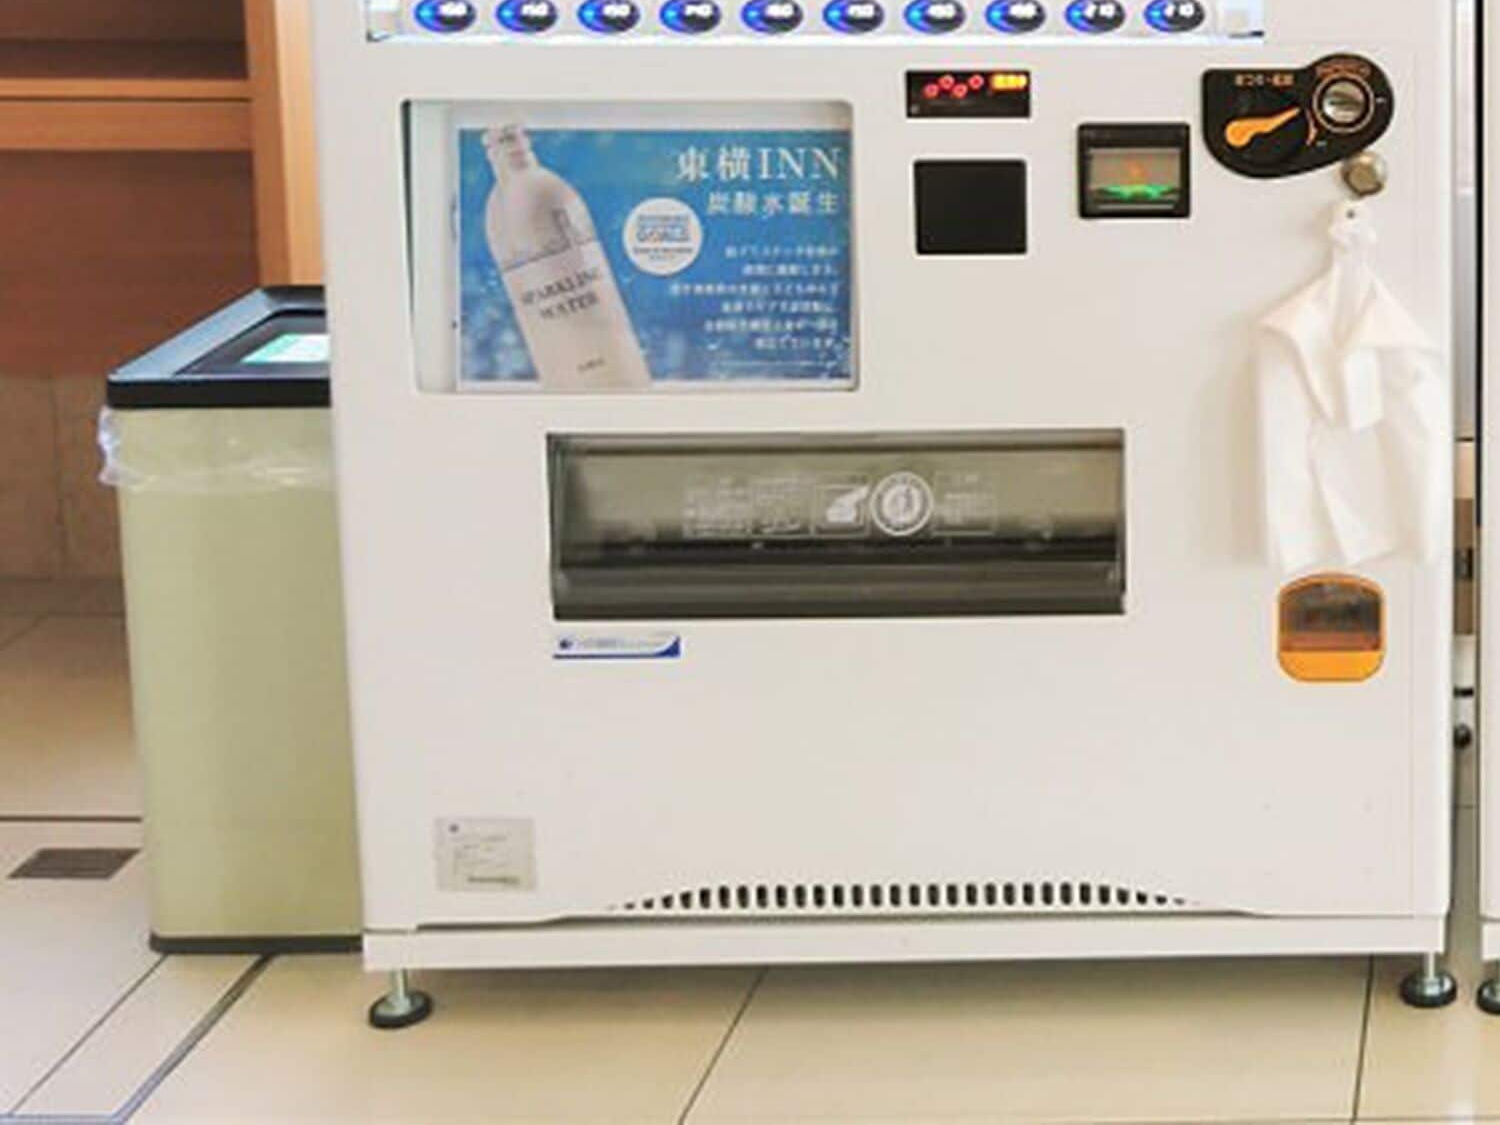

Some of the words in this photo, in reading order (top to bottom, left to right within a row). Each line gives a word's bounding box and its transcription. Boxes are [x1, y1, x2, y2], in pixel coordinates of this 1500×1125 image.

[677, 145, 841, 181] 東横INN
[706, 191, 838, 218] 炭酸水誕生
